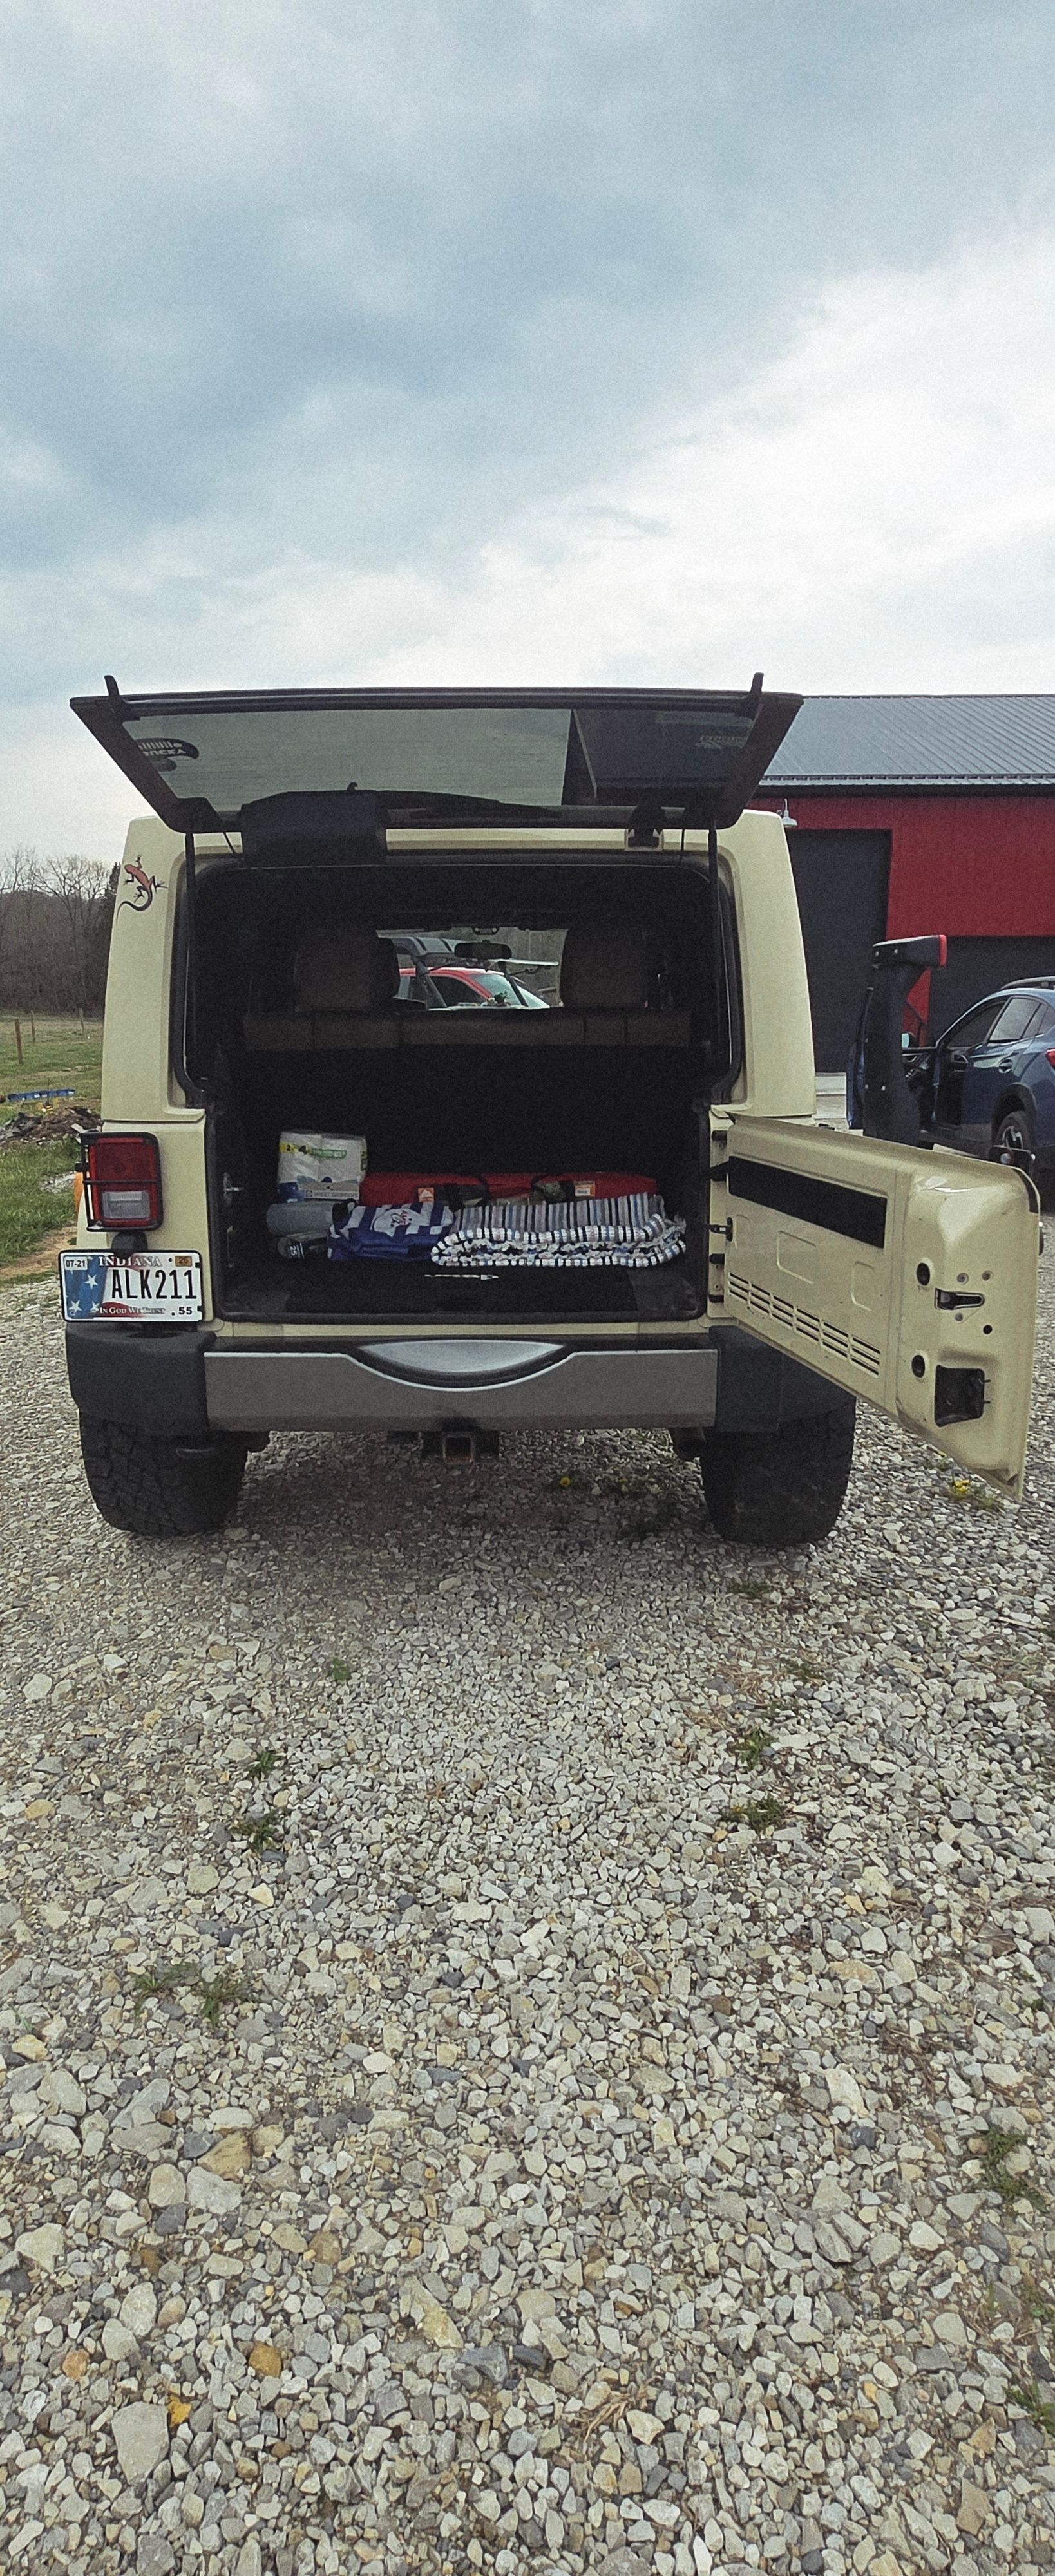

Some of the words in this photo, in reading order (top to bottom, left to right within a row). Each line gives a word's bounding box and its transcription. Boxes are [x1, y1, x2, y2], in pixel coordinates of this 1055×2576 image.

[99, 1256, 163, 1267] INDIANA
[111, 1269, 197, 1299] ALK211
[178, 1307, 193, 1315] 55
